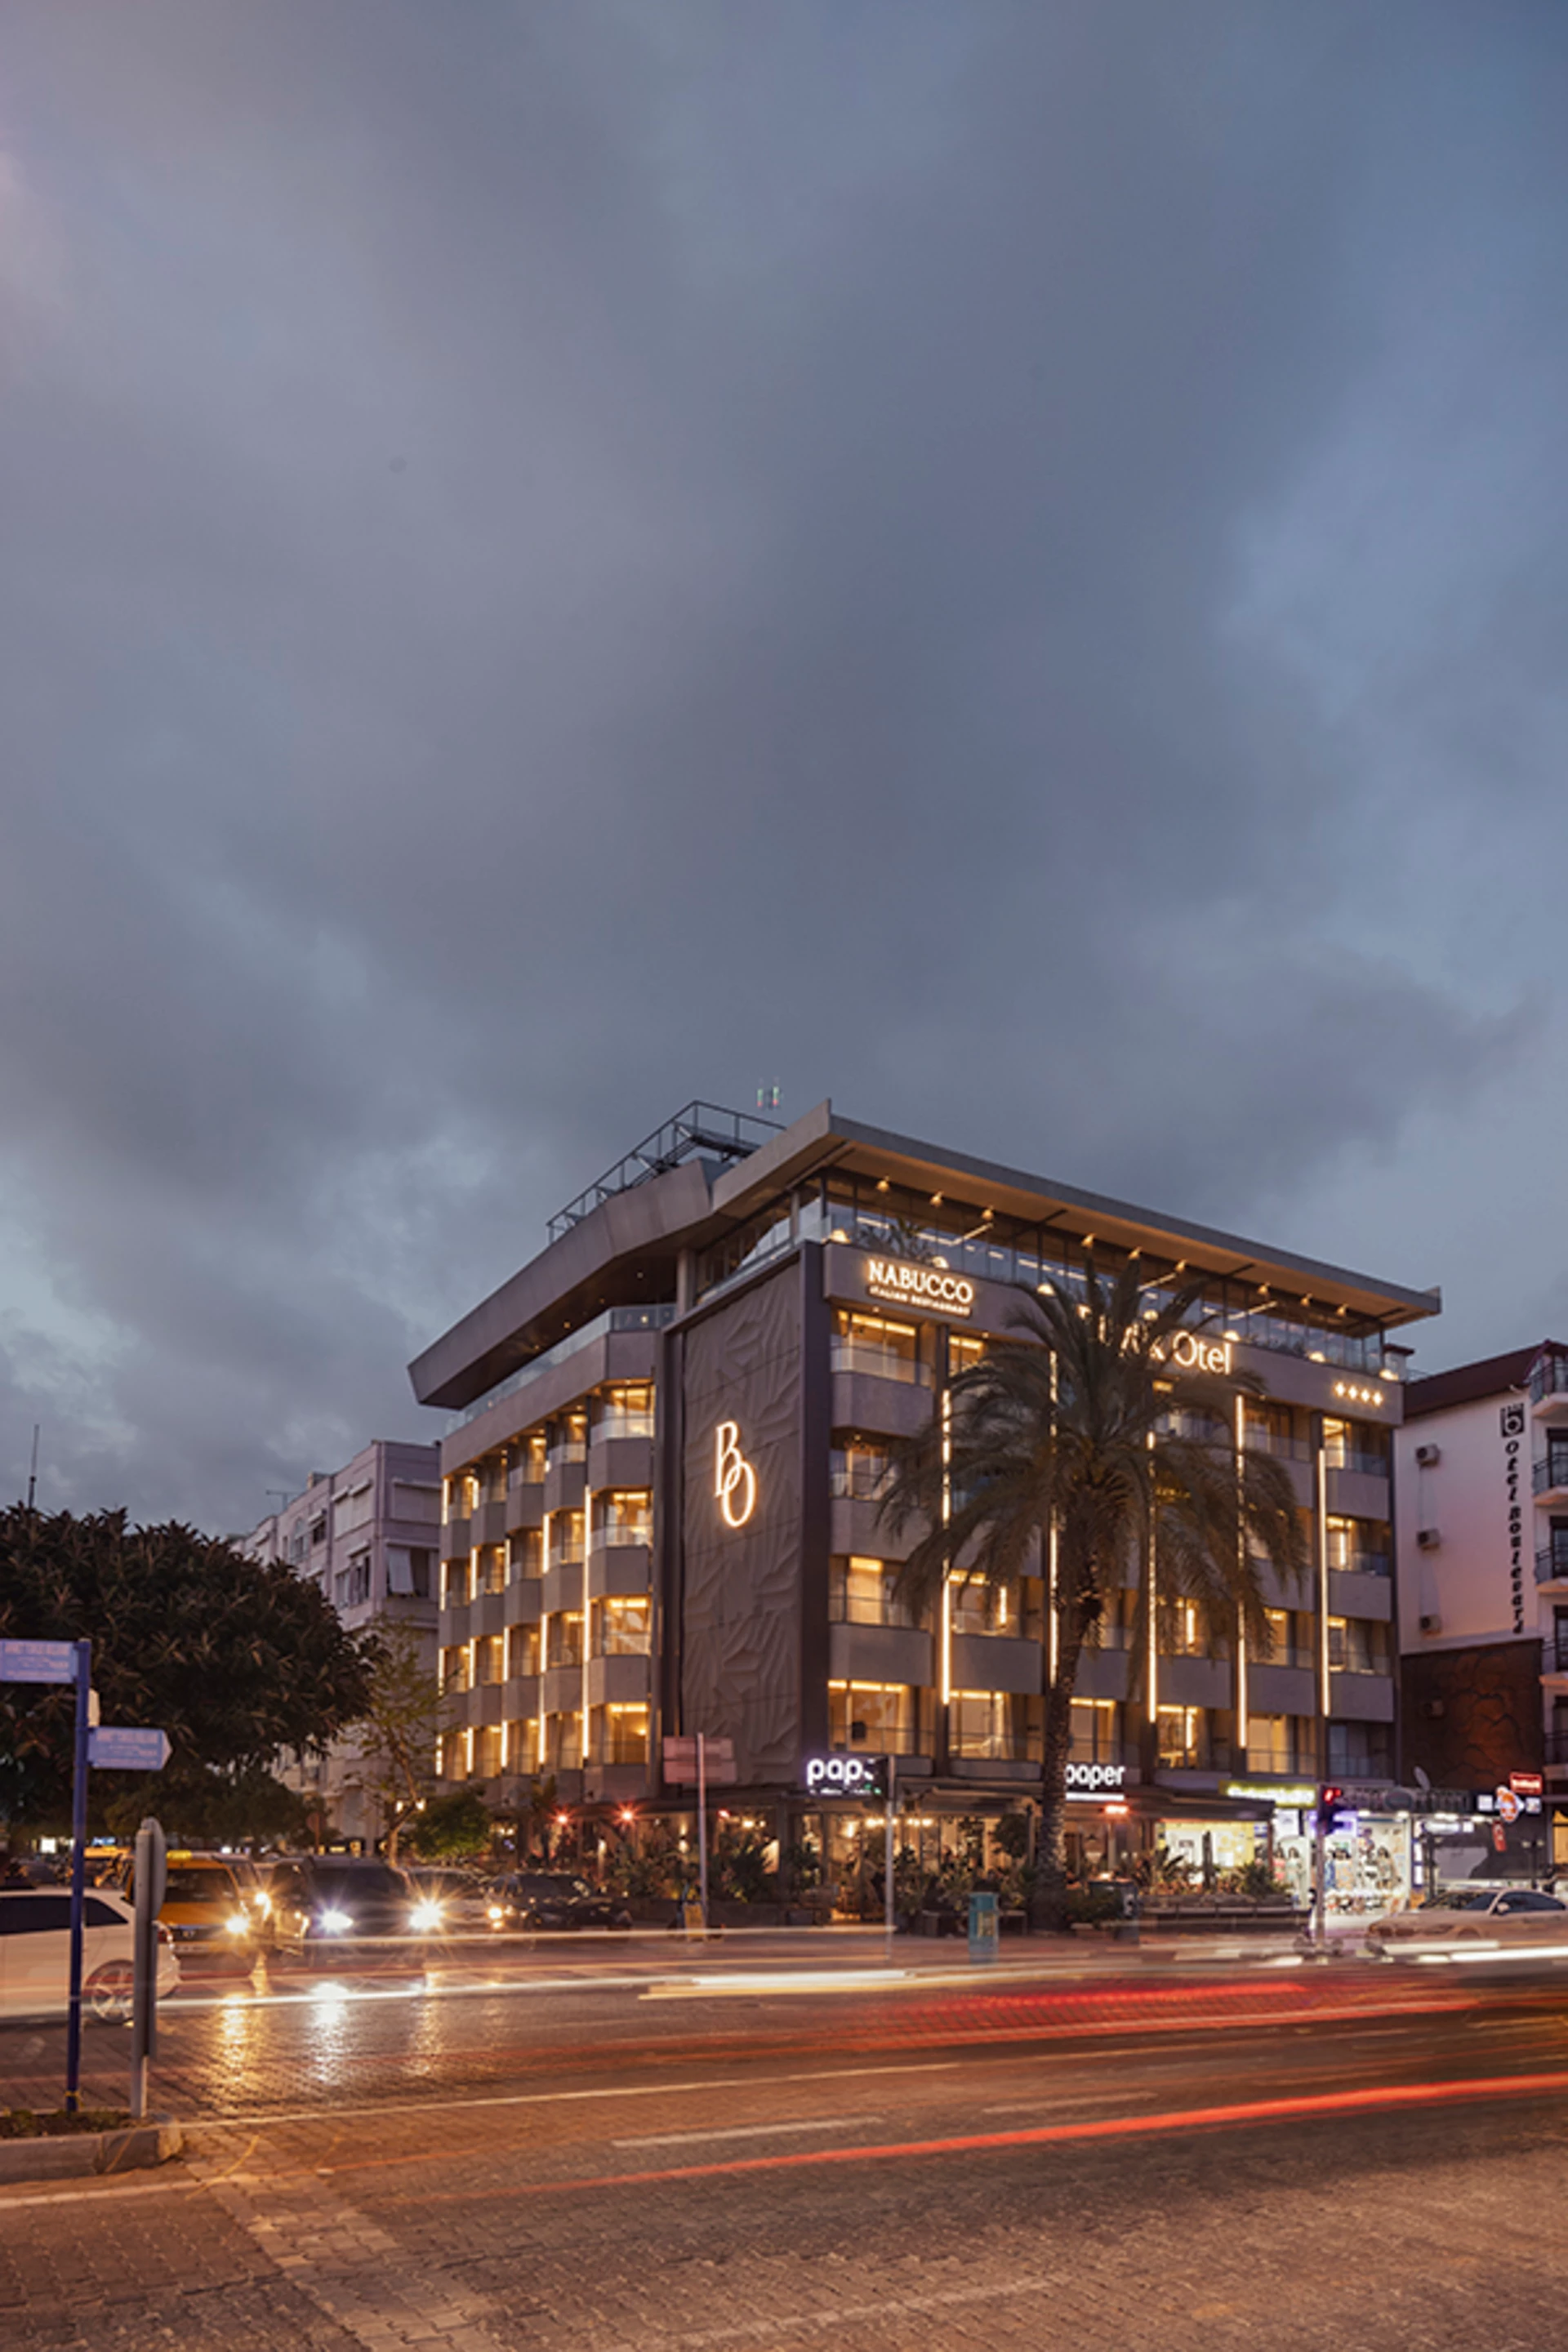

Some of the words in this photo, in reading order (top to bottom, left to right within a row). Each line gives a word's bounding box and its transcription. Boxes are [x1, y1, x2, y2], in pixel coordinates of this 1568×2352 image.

[867, 1258, 973, 1304] NABUCCO
[1172, 1330, 1232, 1375] Otel
[1064, 1763, 1125, 1791] paper
